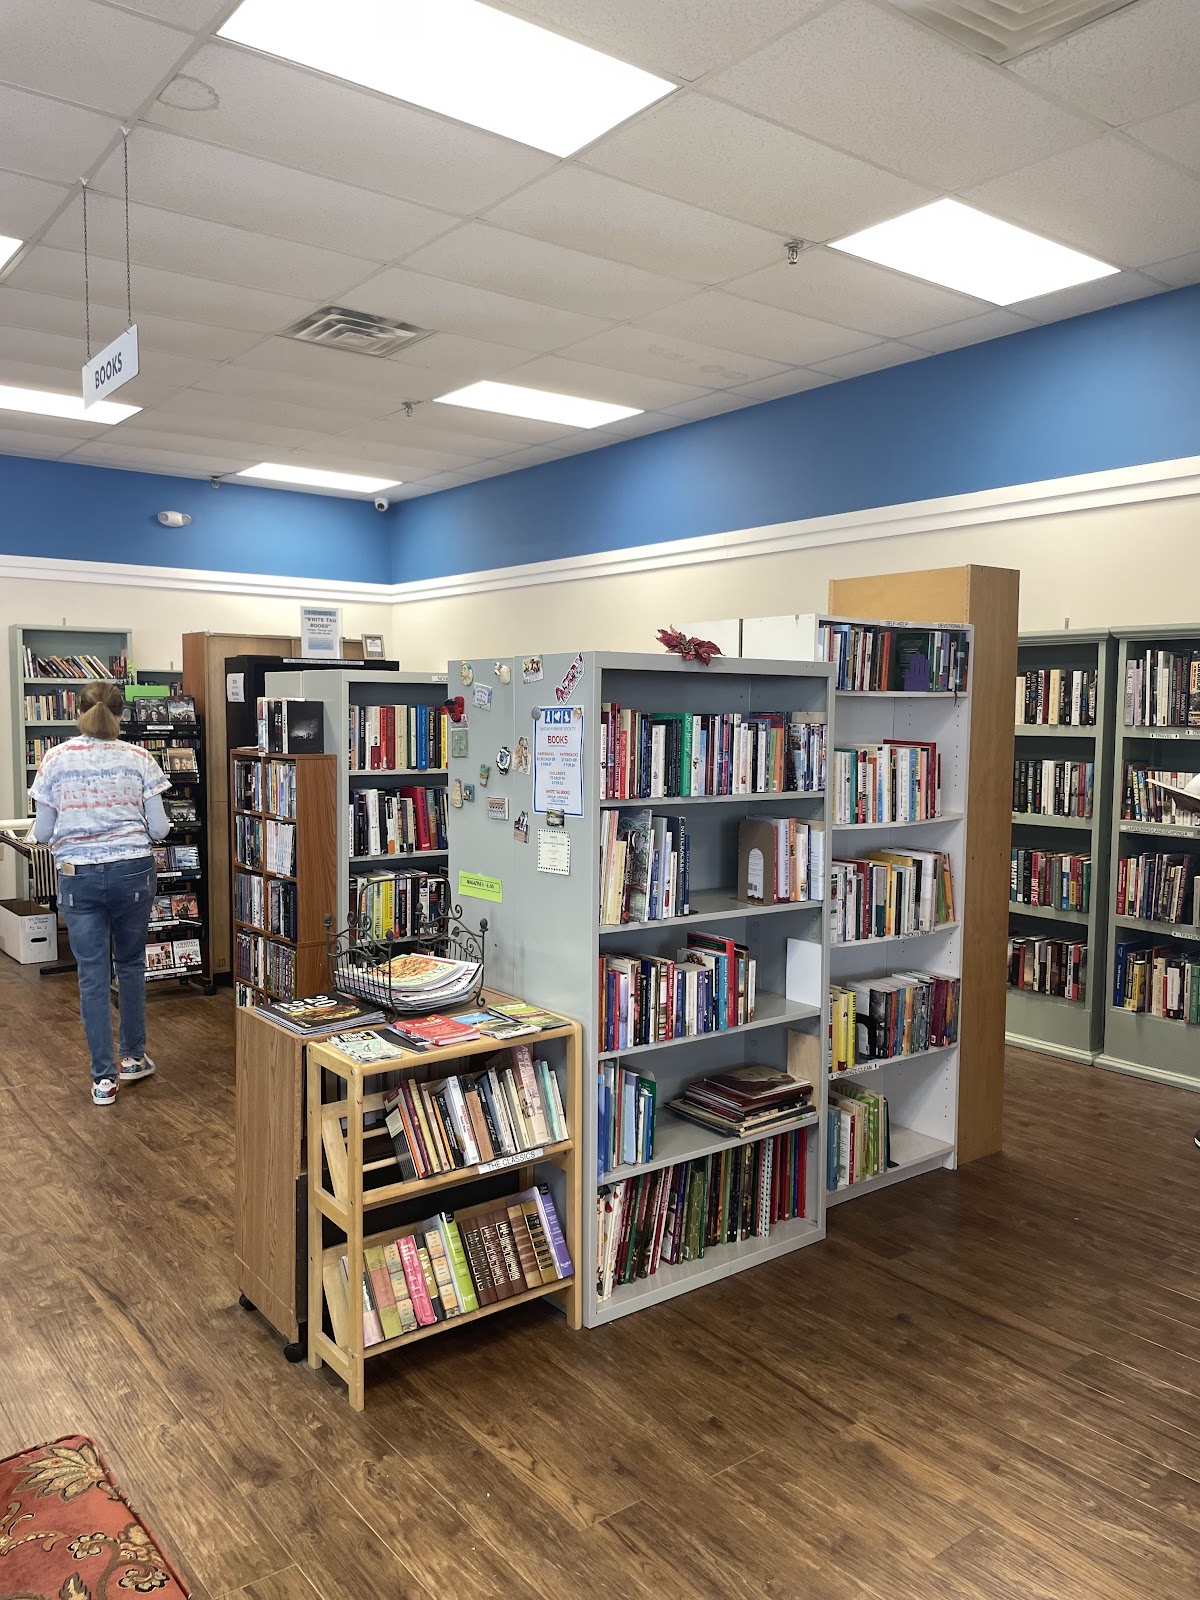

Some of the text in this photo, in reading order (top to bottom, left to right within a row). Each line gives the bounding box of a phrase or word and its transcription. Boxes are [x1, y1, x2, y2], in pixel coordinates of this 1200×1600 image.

[95, 352, 122, 389] BOOKS
[548, 735, 568, 744] BOOKS
[1031, 878, 1039, 890] DRY
[519, 1062, 527, 1085] LIGHT
[461, 1105, 470, 1125] ROBINSON
[486, 1150, 536, 1171] THE CLASSICS
